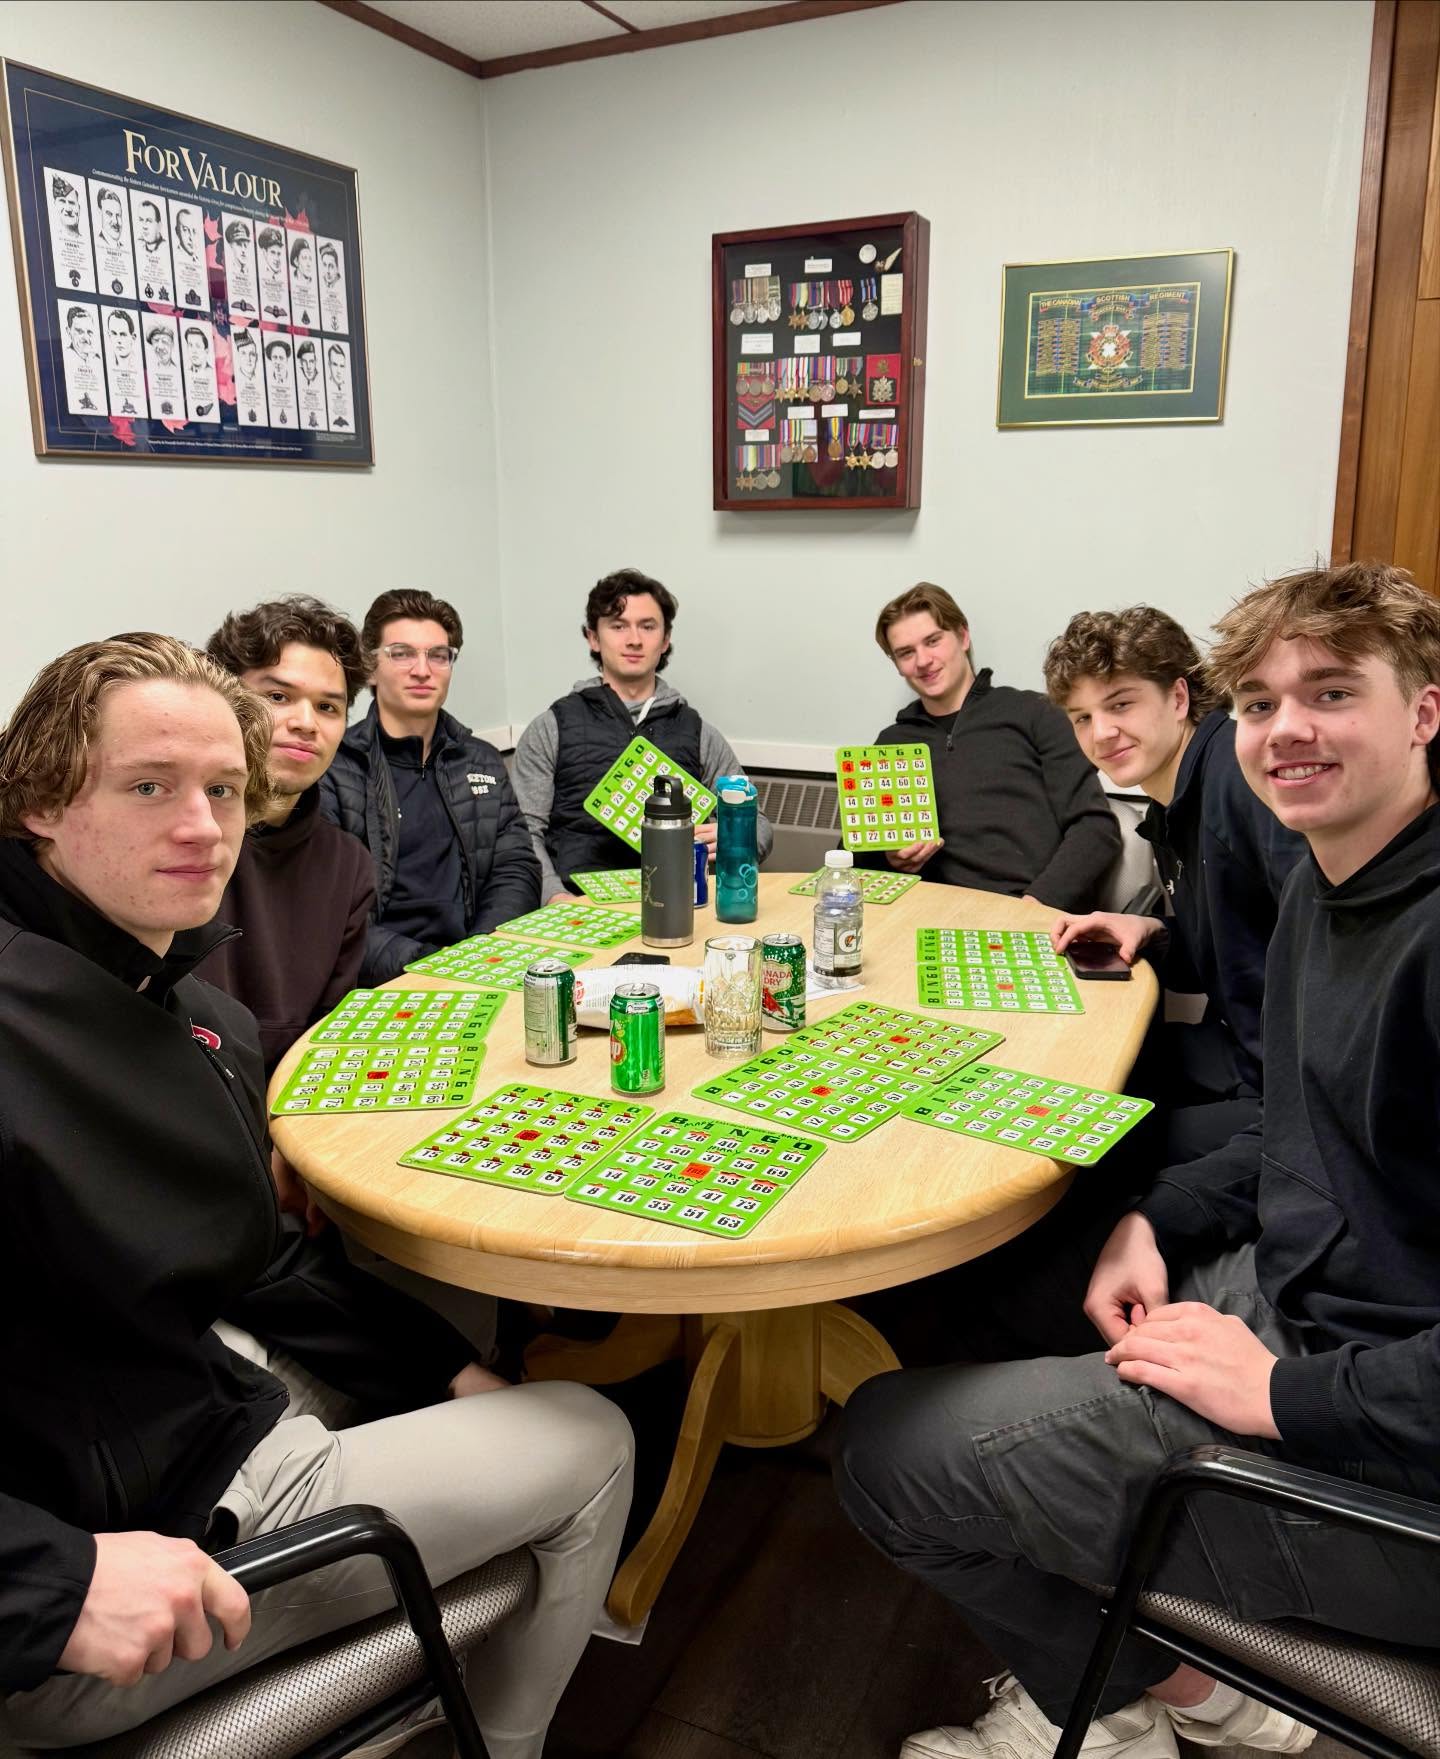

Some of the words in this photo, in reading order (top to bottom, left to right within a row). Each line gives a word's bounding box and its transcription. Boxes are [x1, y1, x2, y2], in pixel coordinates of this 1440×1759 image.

[123, 128, 184, 182] FOR
[178, 146, 284, 208] VALOUR
[1150, 291, 1186, 301] REGIMENT
[846, 764, 851, 772] 4
[916, 778, 926, 786] 62
[847, 798, 857, 806] 14
[900, 796, 910, 804] 54
[918, 795, 928, 803] 72
[885, 814, 894, 822] 31
[920, 812, 930, 820] 75
[922, 830, 932, 838] 74
[763, 969, 793, 979] NADA
[490, 1127, 511, 1135] 23
[567, 1124, 587, 1132] 52
[470, 1141, 491, 1149] 24
[531, 1152, 552, 1160] 59
[561, 1158, 583, 1167] 75
[686, 1134, 707, 1142] 26
[717, 1140, 738, 1149] 40
[749, 1147, 771, 1155] 59
[782, 1153, 803, 1163] 61
[637, 1141, 660, 1150] 12
[669, 1147, 691, 1156] 30
[701, 1154, 723, 1163] 37
[733, 1161, 755, 1170] 54
[766, 1168, 789, 1178] 69
[418, 1150, 441, 1159] 15
[449, 1156, 471, 1164] 30
[480, 1161, 502, 1170] 37
[511, 1167, 534, 1176] 50
[543, 1174, 564, 1183] 61
[652, 1162, 674, 1171] 24
[717, 1176, 740, 1186] 53
[751, 1183, 774, 1194] 66
[600, 1170, 624, 1180] 14
[633, 1177, 656, 1187] 20
[666, 1184, 690, 1194] 36
[700, 1192, 723, 1202] 47
[735, 1200, 758, 1210] 73
[586, 1187, 600, 1195] 8
[615, 1193, 637, 1203] 18
[647, 1201, 671, 1211] 33
[682, 1209, 705, 1219] 51
[717, 1217, 741, 1228] 63
